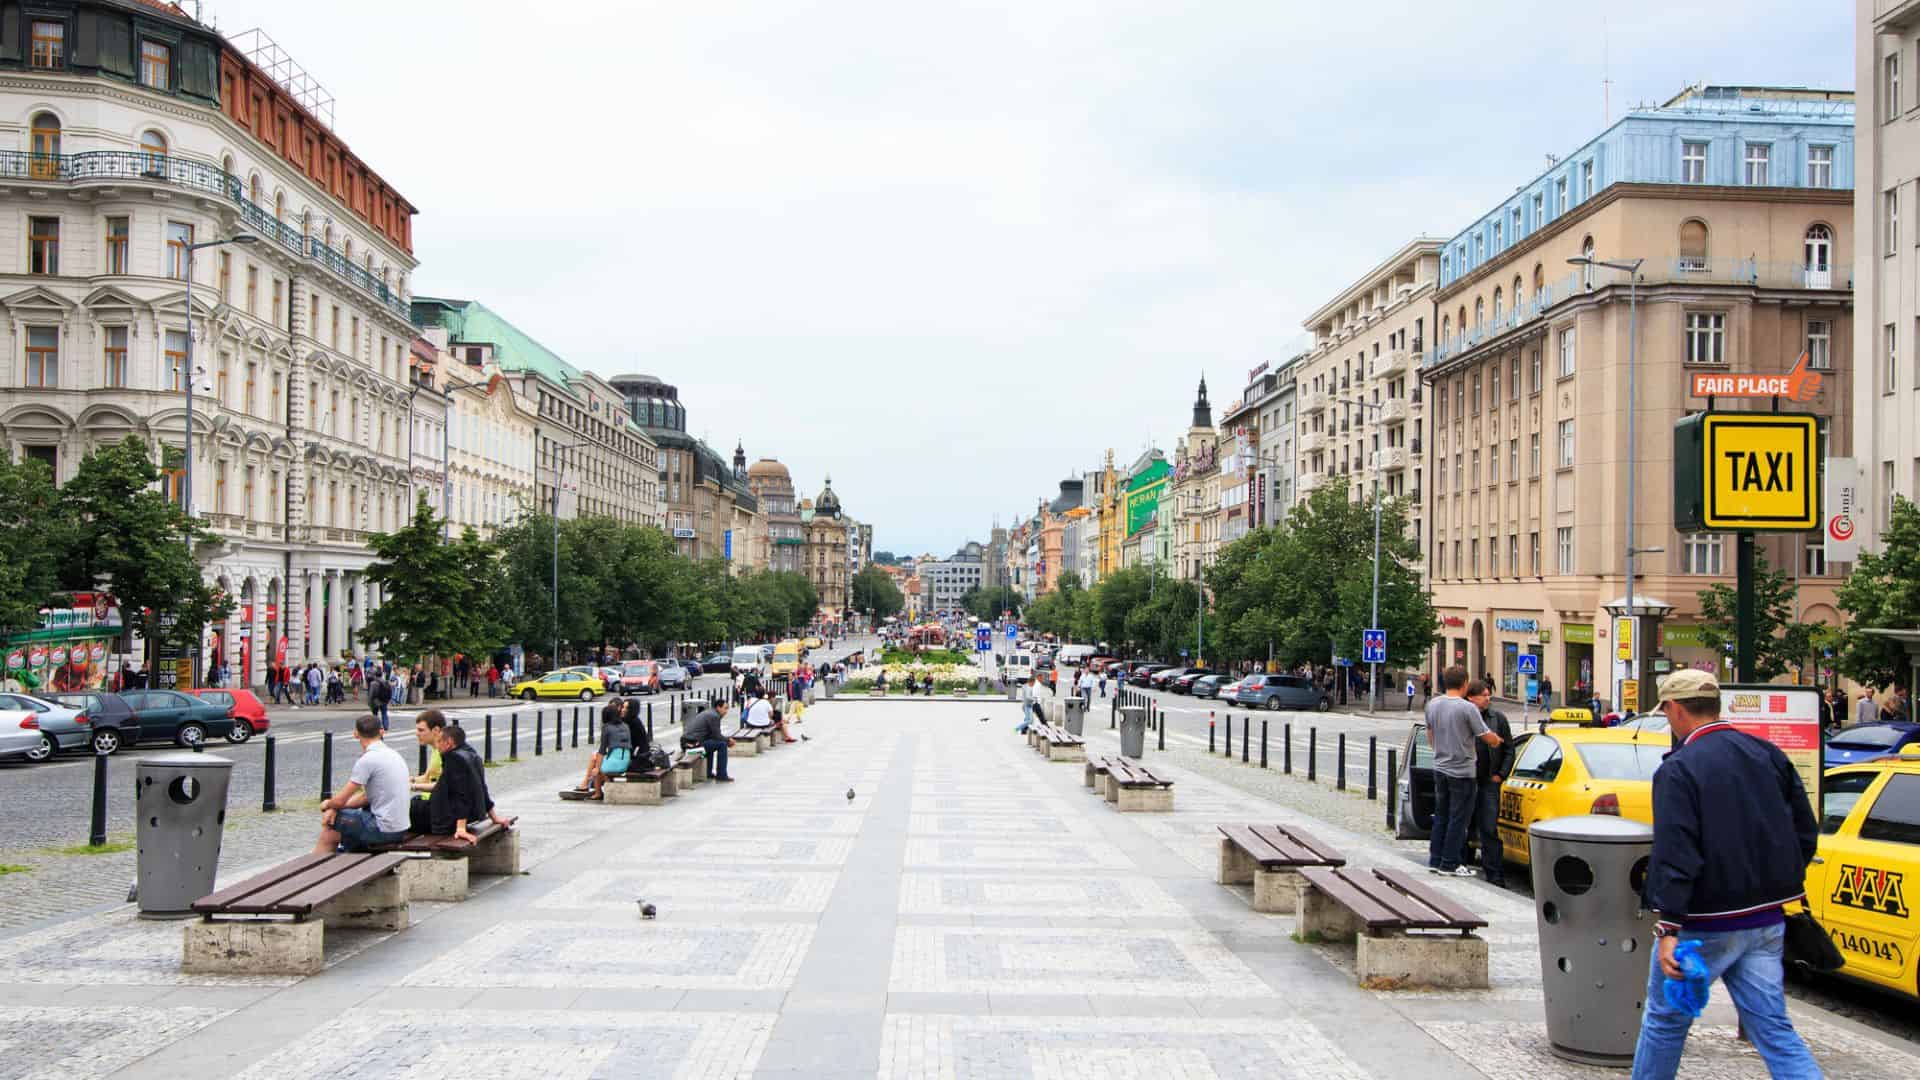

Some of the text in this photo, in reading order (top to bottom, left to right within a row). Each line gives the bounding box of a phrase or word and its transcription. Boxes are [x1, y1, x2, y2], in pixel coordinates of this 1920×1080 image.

[1697, 378, 1789, 394] FAIR PLACE
[1725, 452, 1792, 492] TAXI
[1831, 864, 1909, 918] AAA
